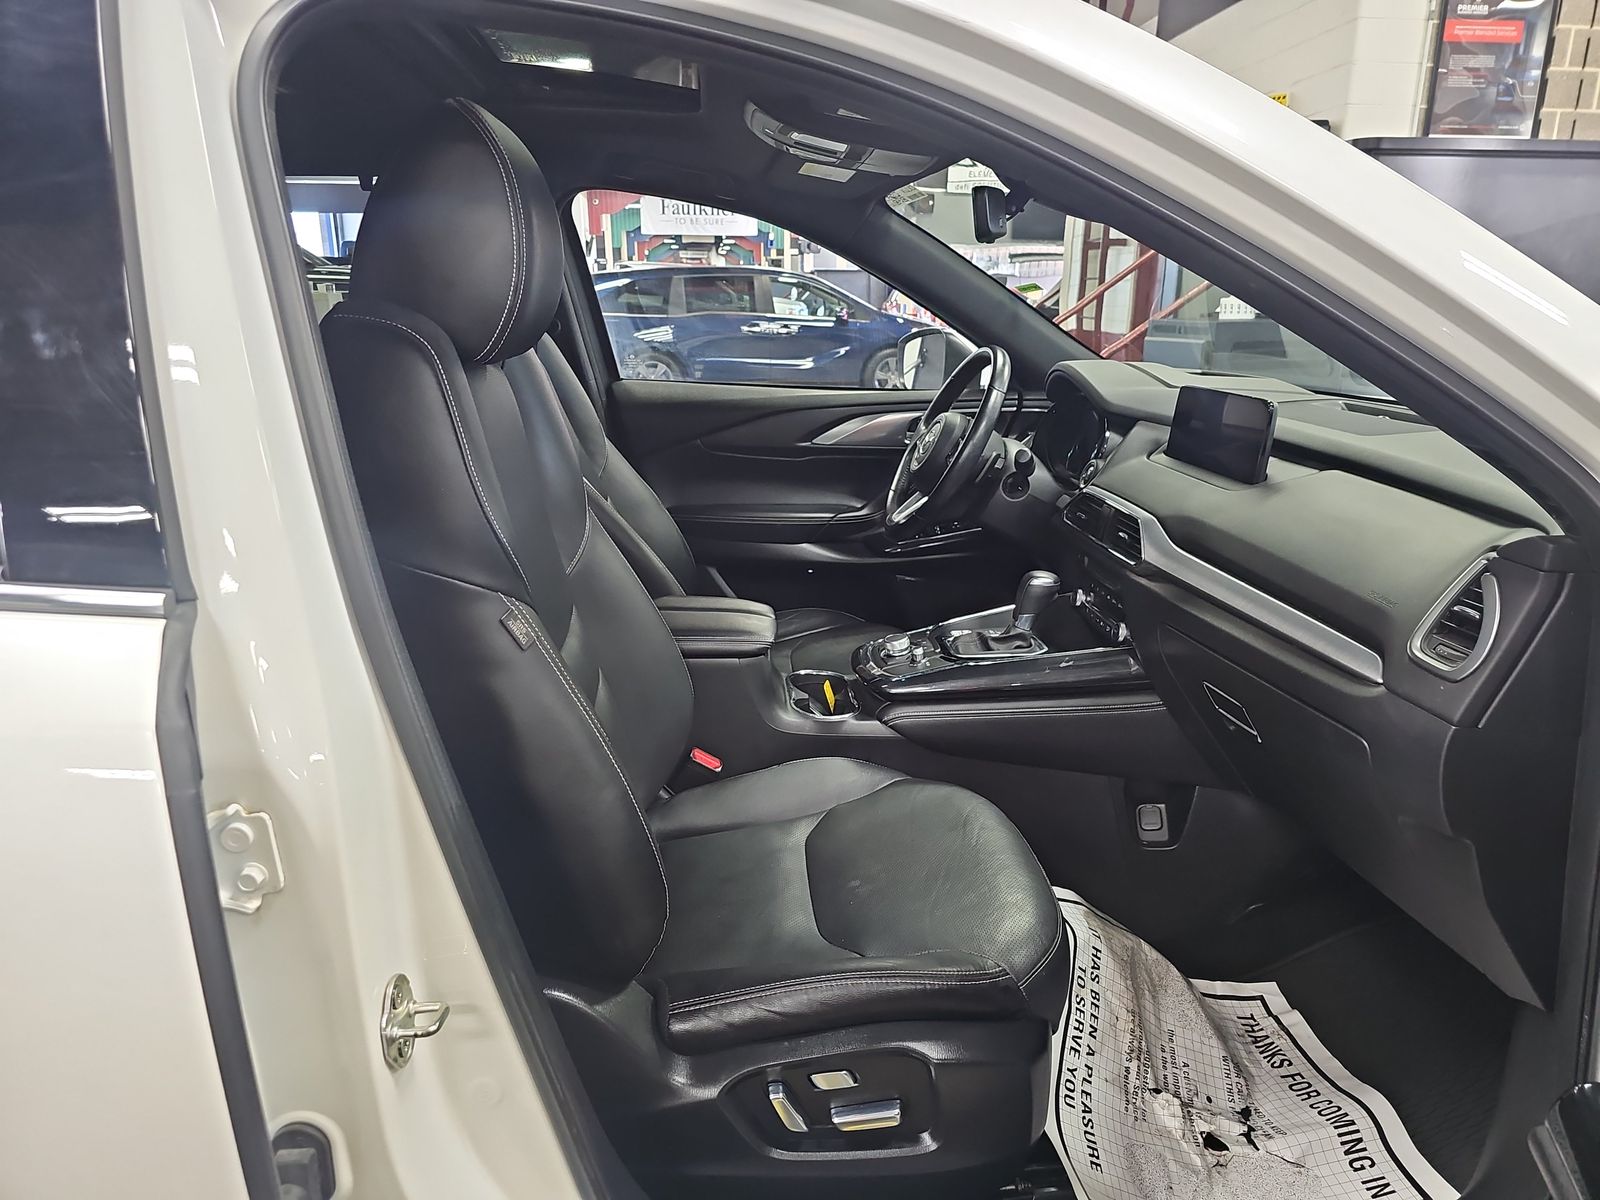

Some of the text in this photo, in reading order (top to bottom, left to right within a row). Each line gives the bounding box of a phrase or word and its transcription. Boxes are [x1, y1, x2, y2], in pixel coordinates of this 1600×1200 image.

[1457, 4, 1488, 12] PREMIER
[674, 217, 725, 226] TO BE SURE
[1063, 965, 1087, 1110] TO SERVE YOU
[1124, 1027, 1137, 1063] always
[1167, 1028, 1176, 1044] the
[1080, 926, 1104, 1175] IT HAS BEEN A PLEASURE
[1160, 1044, 1167, 1054] in
[1168, 1046, 1180, 1070] most
[1181, 1060, 1190, 1068] A
[1222, 1055, 1232, 1080] WITH
[1131, 1084, 1141, 1122] Service
[1225, 1082, 1236, 1104] THIS
[1236, 1013, 1397, 1199] THANKS FOR COMING IN
[1262, 1118, 1274, 1126] TO
[1271, 1125, 1288, 1136] KEEP
